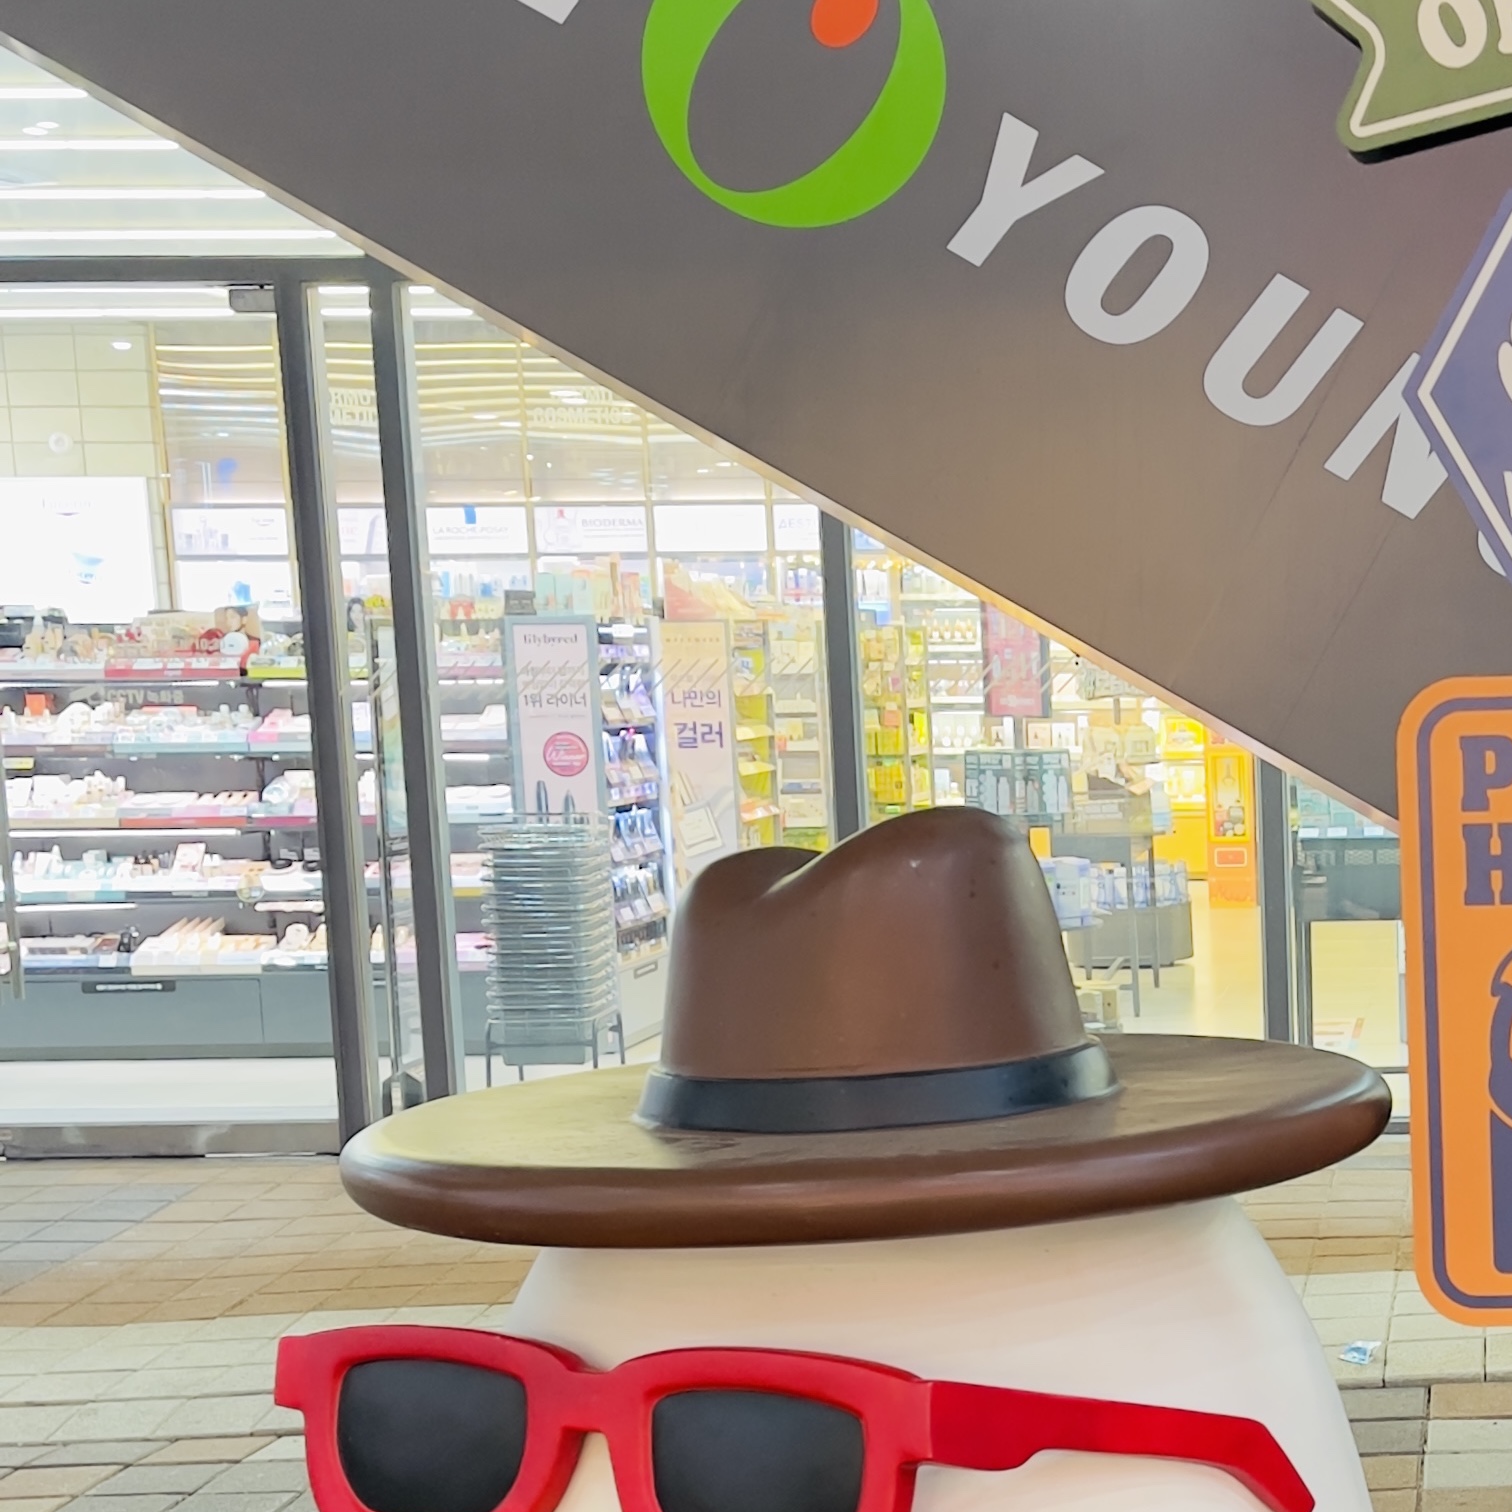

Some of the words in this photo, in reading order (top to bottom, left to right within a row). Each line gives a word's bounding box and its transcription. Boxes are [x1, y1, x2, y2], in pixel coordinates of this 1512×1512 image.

[581, 518, 644, 528] BIODERMA
[523, 633, 578, 647] lilybyred
[546, 692, 587, 708] 라이너
[670, 688, 722, 709] 나만의
[673, 720, 725, 750] 걸러
